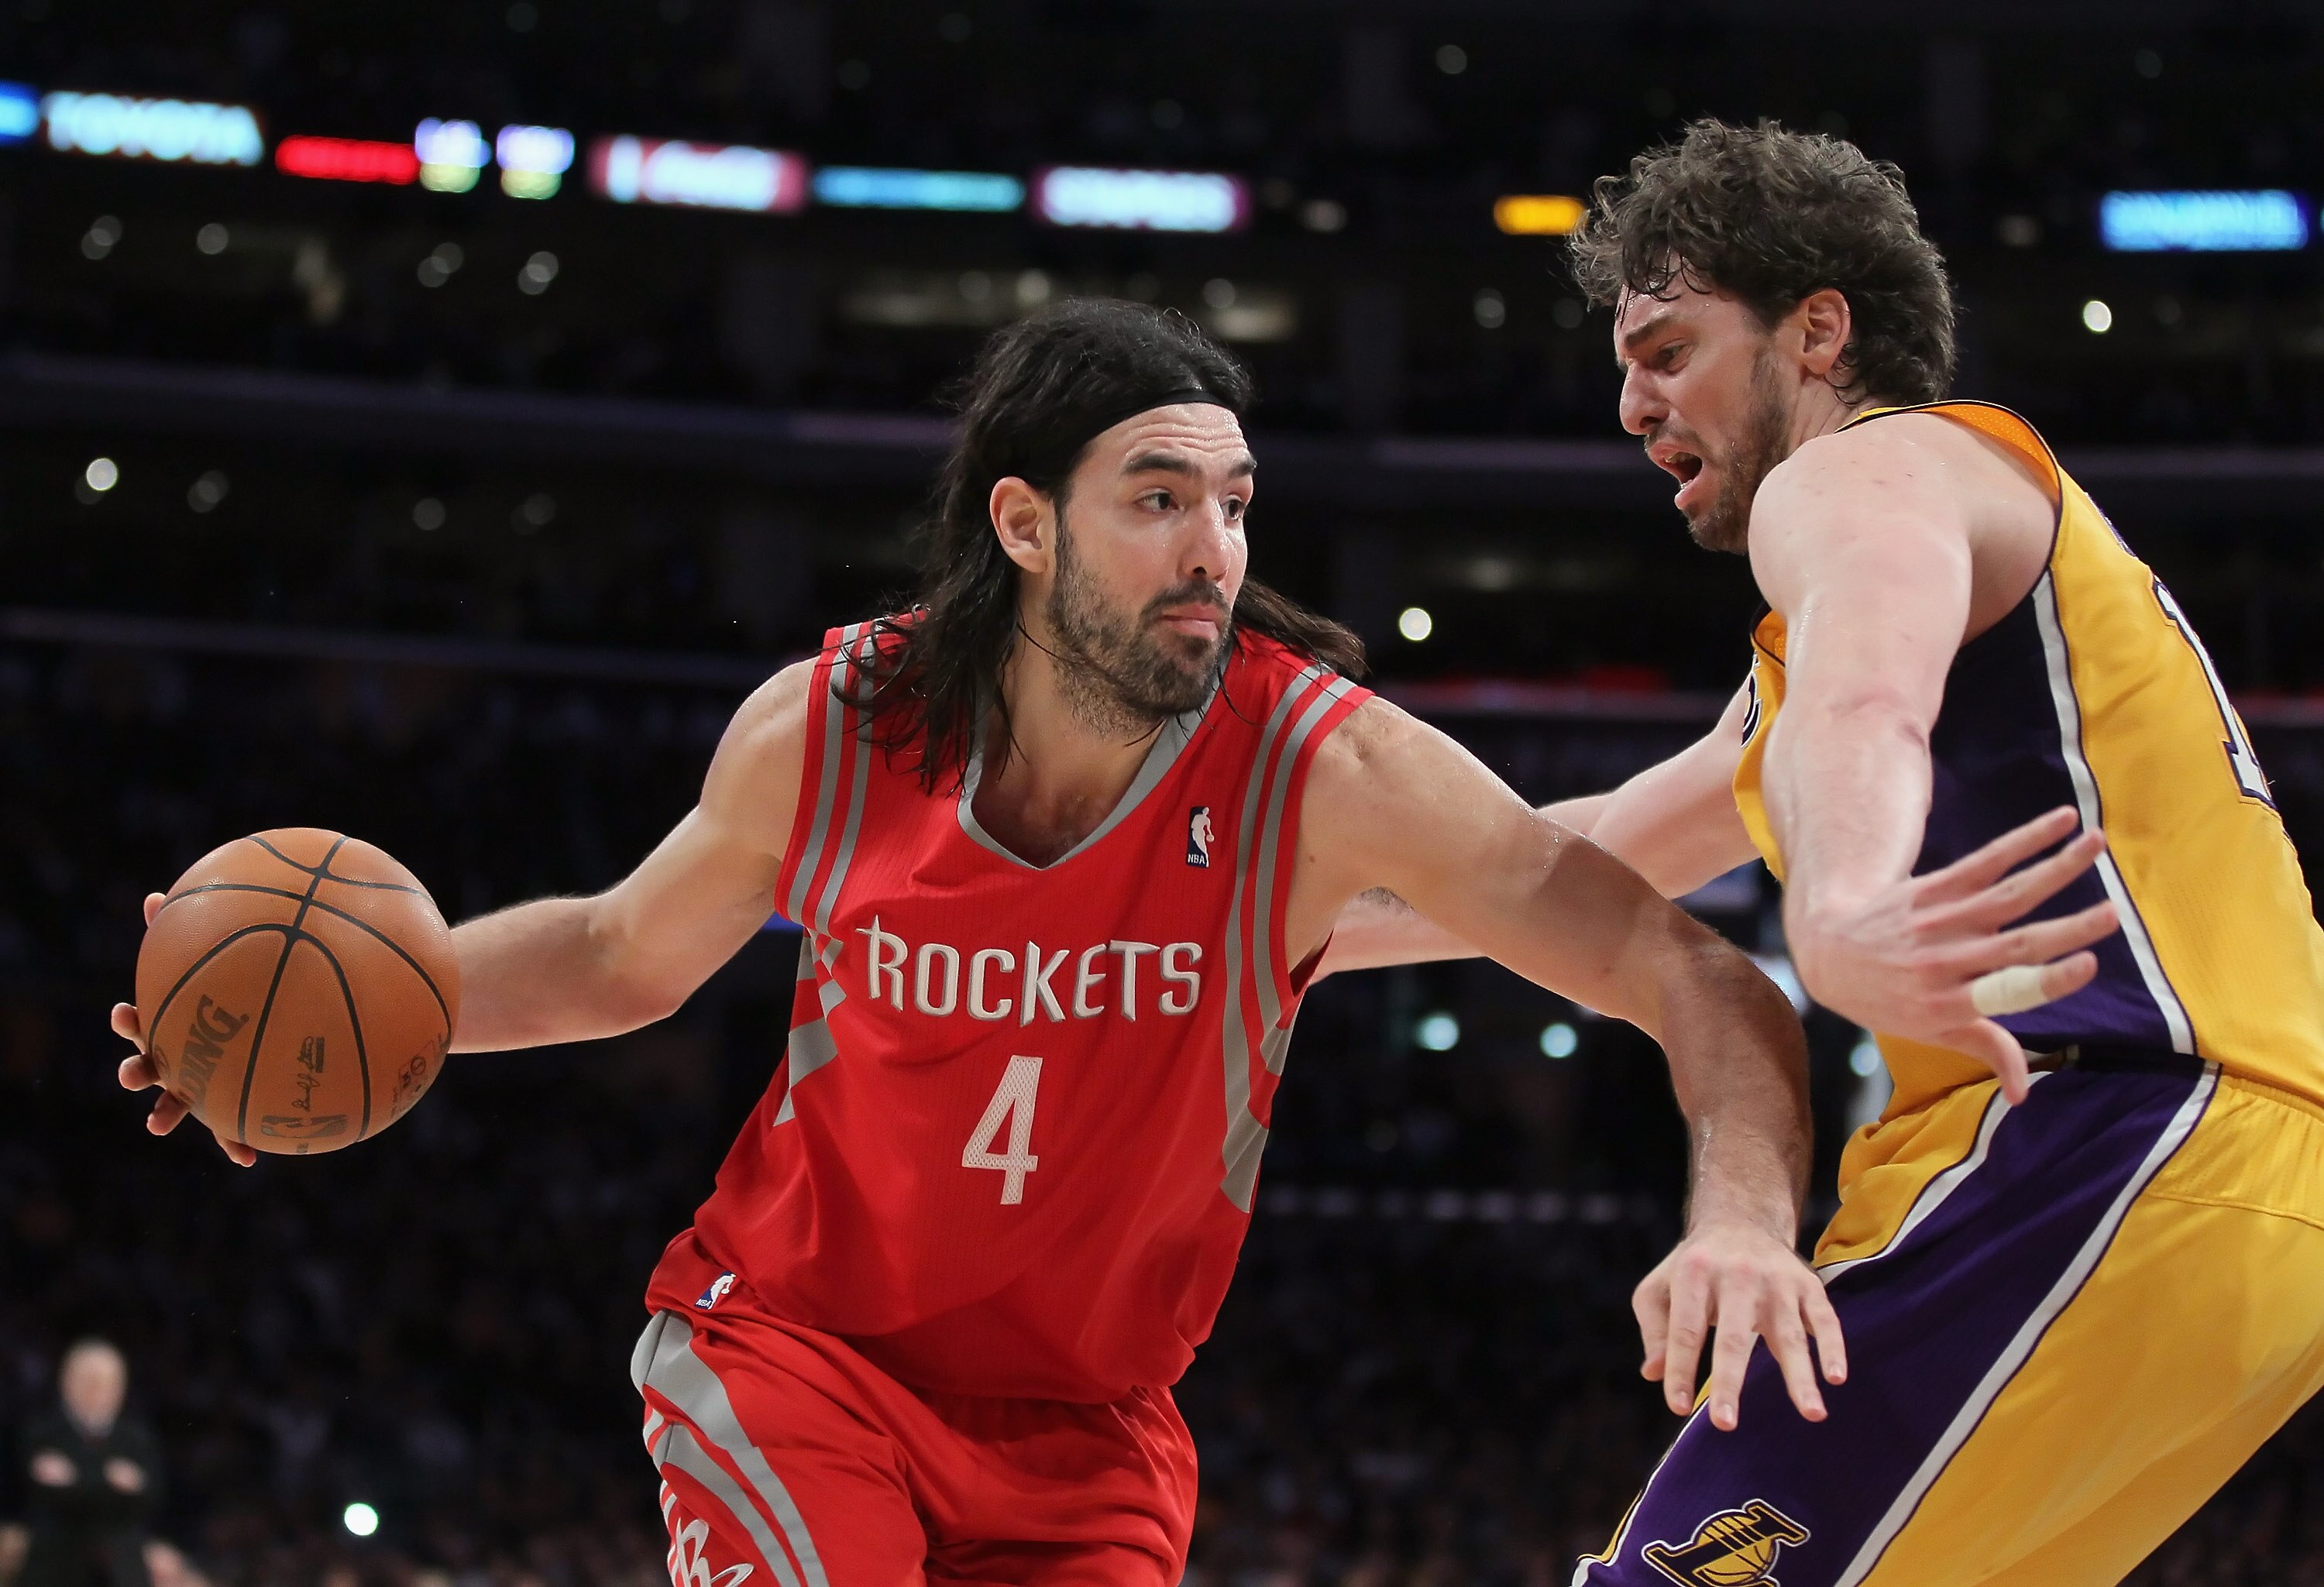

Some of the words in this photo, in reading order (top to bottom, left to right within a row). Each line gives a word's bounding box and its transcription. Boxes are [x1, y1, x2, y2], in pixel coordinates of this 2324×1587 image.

[1188, 854, 1205, 864] NBA
[855, 914, 1203, 1028] ROCKETS
[961, 1054, 1043, 1205] 4
[695, 1298, 711, 1307] NBA
